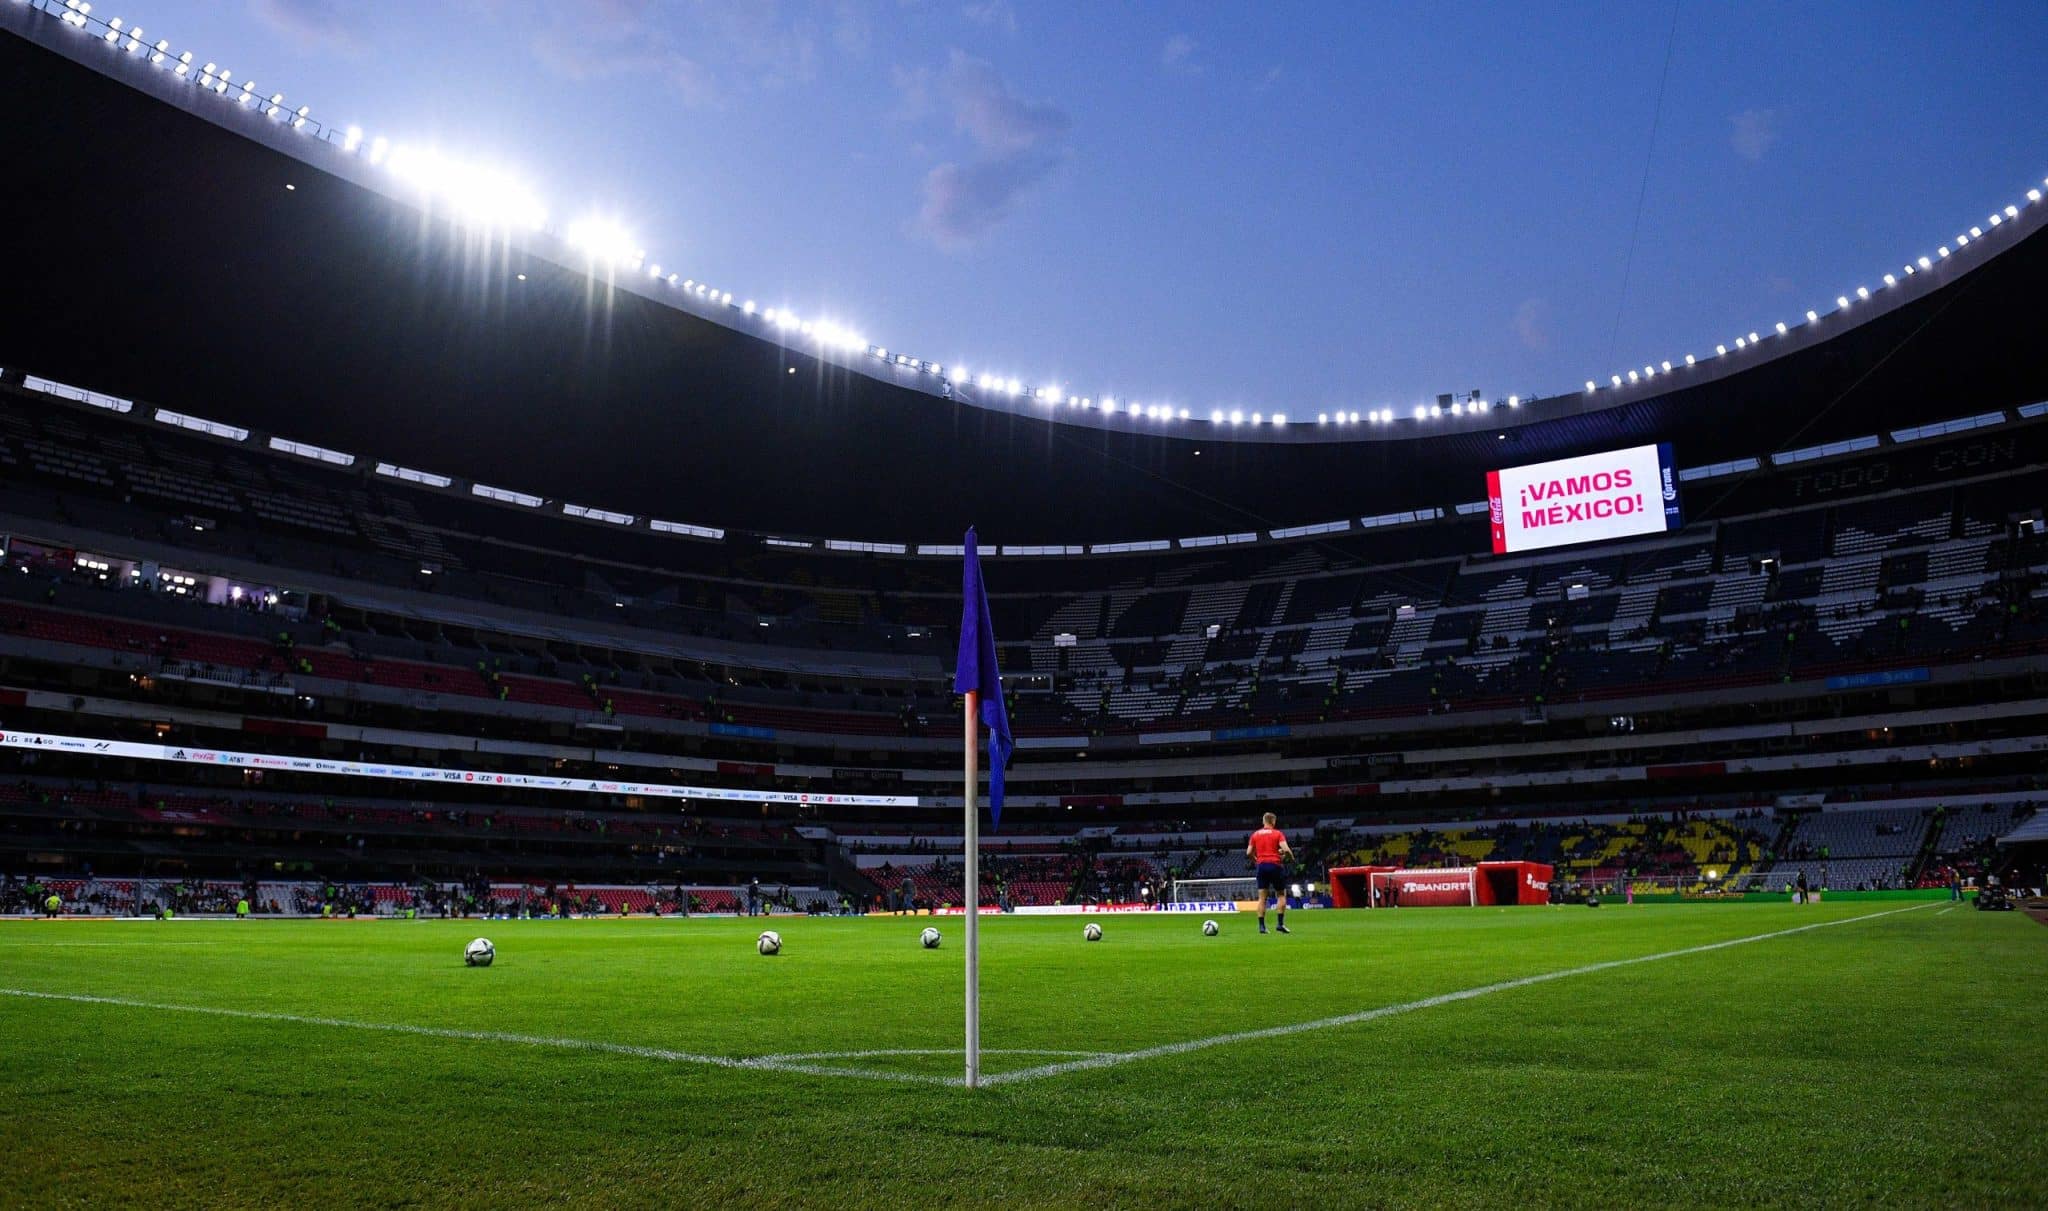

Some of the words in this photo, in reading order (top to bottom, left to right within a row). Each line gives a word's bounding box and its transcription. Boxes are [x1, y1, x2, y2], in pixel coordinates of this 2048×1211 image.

[1520, 469, 1633, 507] ¡VAMOS
[1663, 467, 1677, 501] Corona
[1522, 494, 1643, 529] MÉXICO!
[6, 735, 18, 743] LG
[229, 756, 244, 764] AT&T
[444, 772, 461, 780] VISA
[784, 793, 798, 801] VISA
